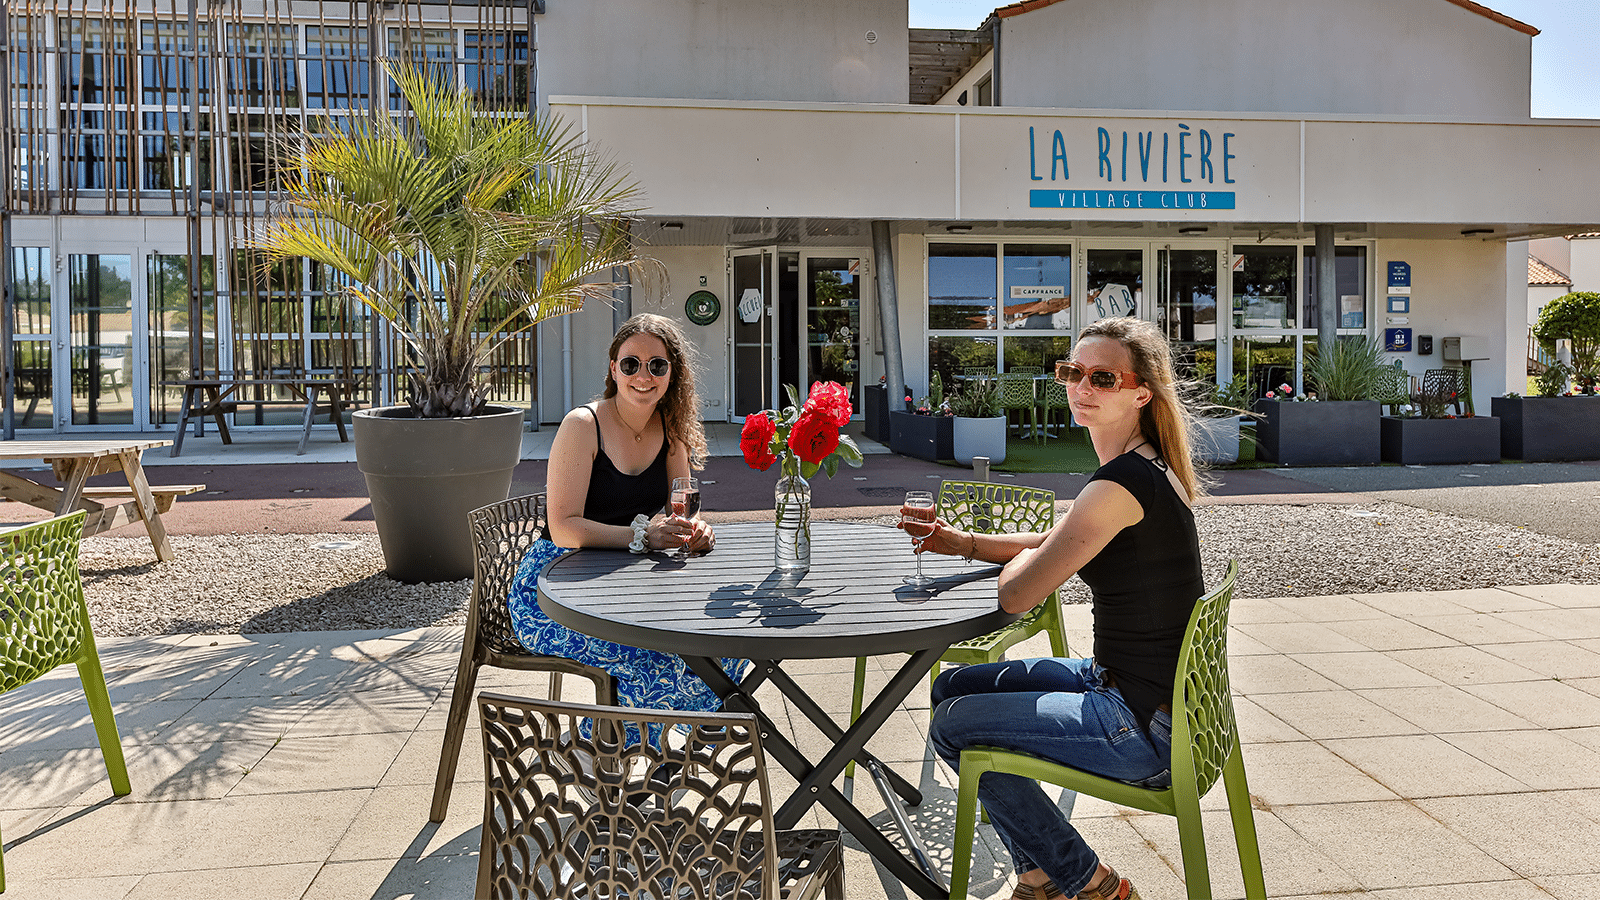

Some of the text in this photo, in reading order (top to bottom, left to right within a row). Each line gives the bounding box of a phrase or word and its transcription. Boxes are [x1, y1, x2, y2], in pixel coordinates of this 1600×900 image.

[1028, 122, 1236, 184] LA RIVIÈRE
[1058, 192, 1208, 208] VILLAGE CLUB
[1094, 288, 1135, 318] BAR
